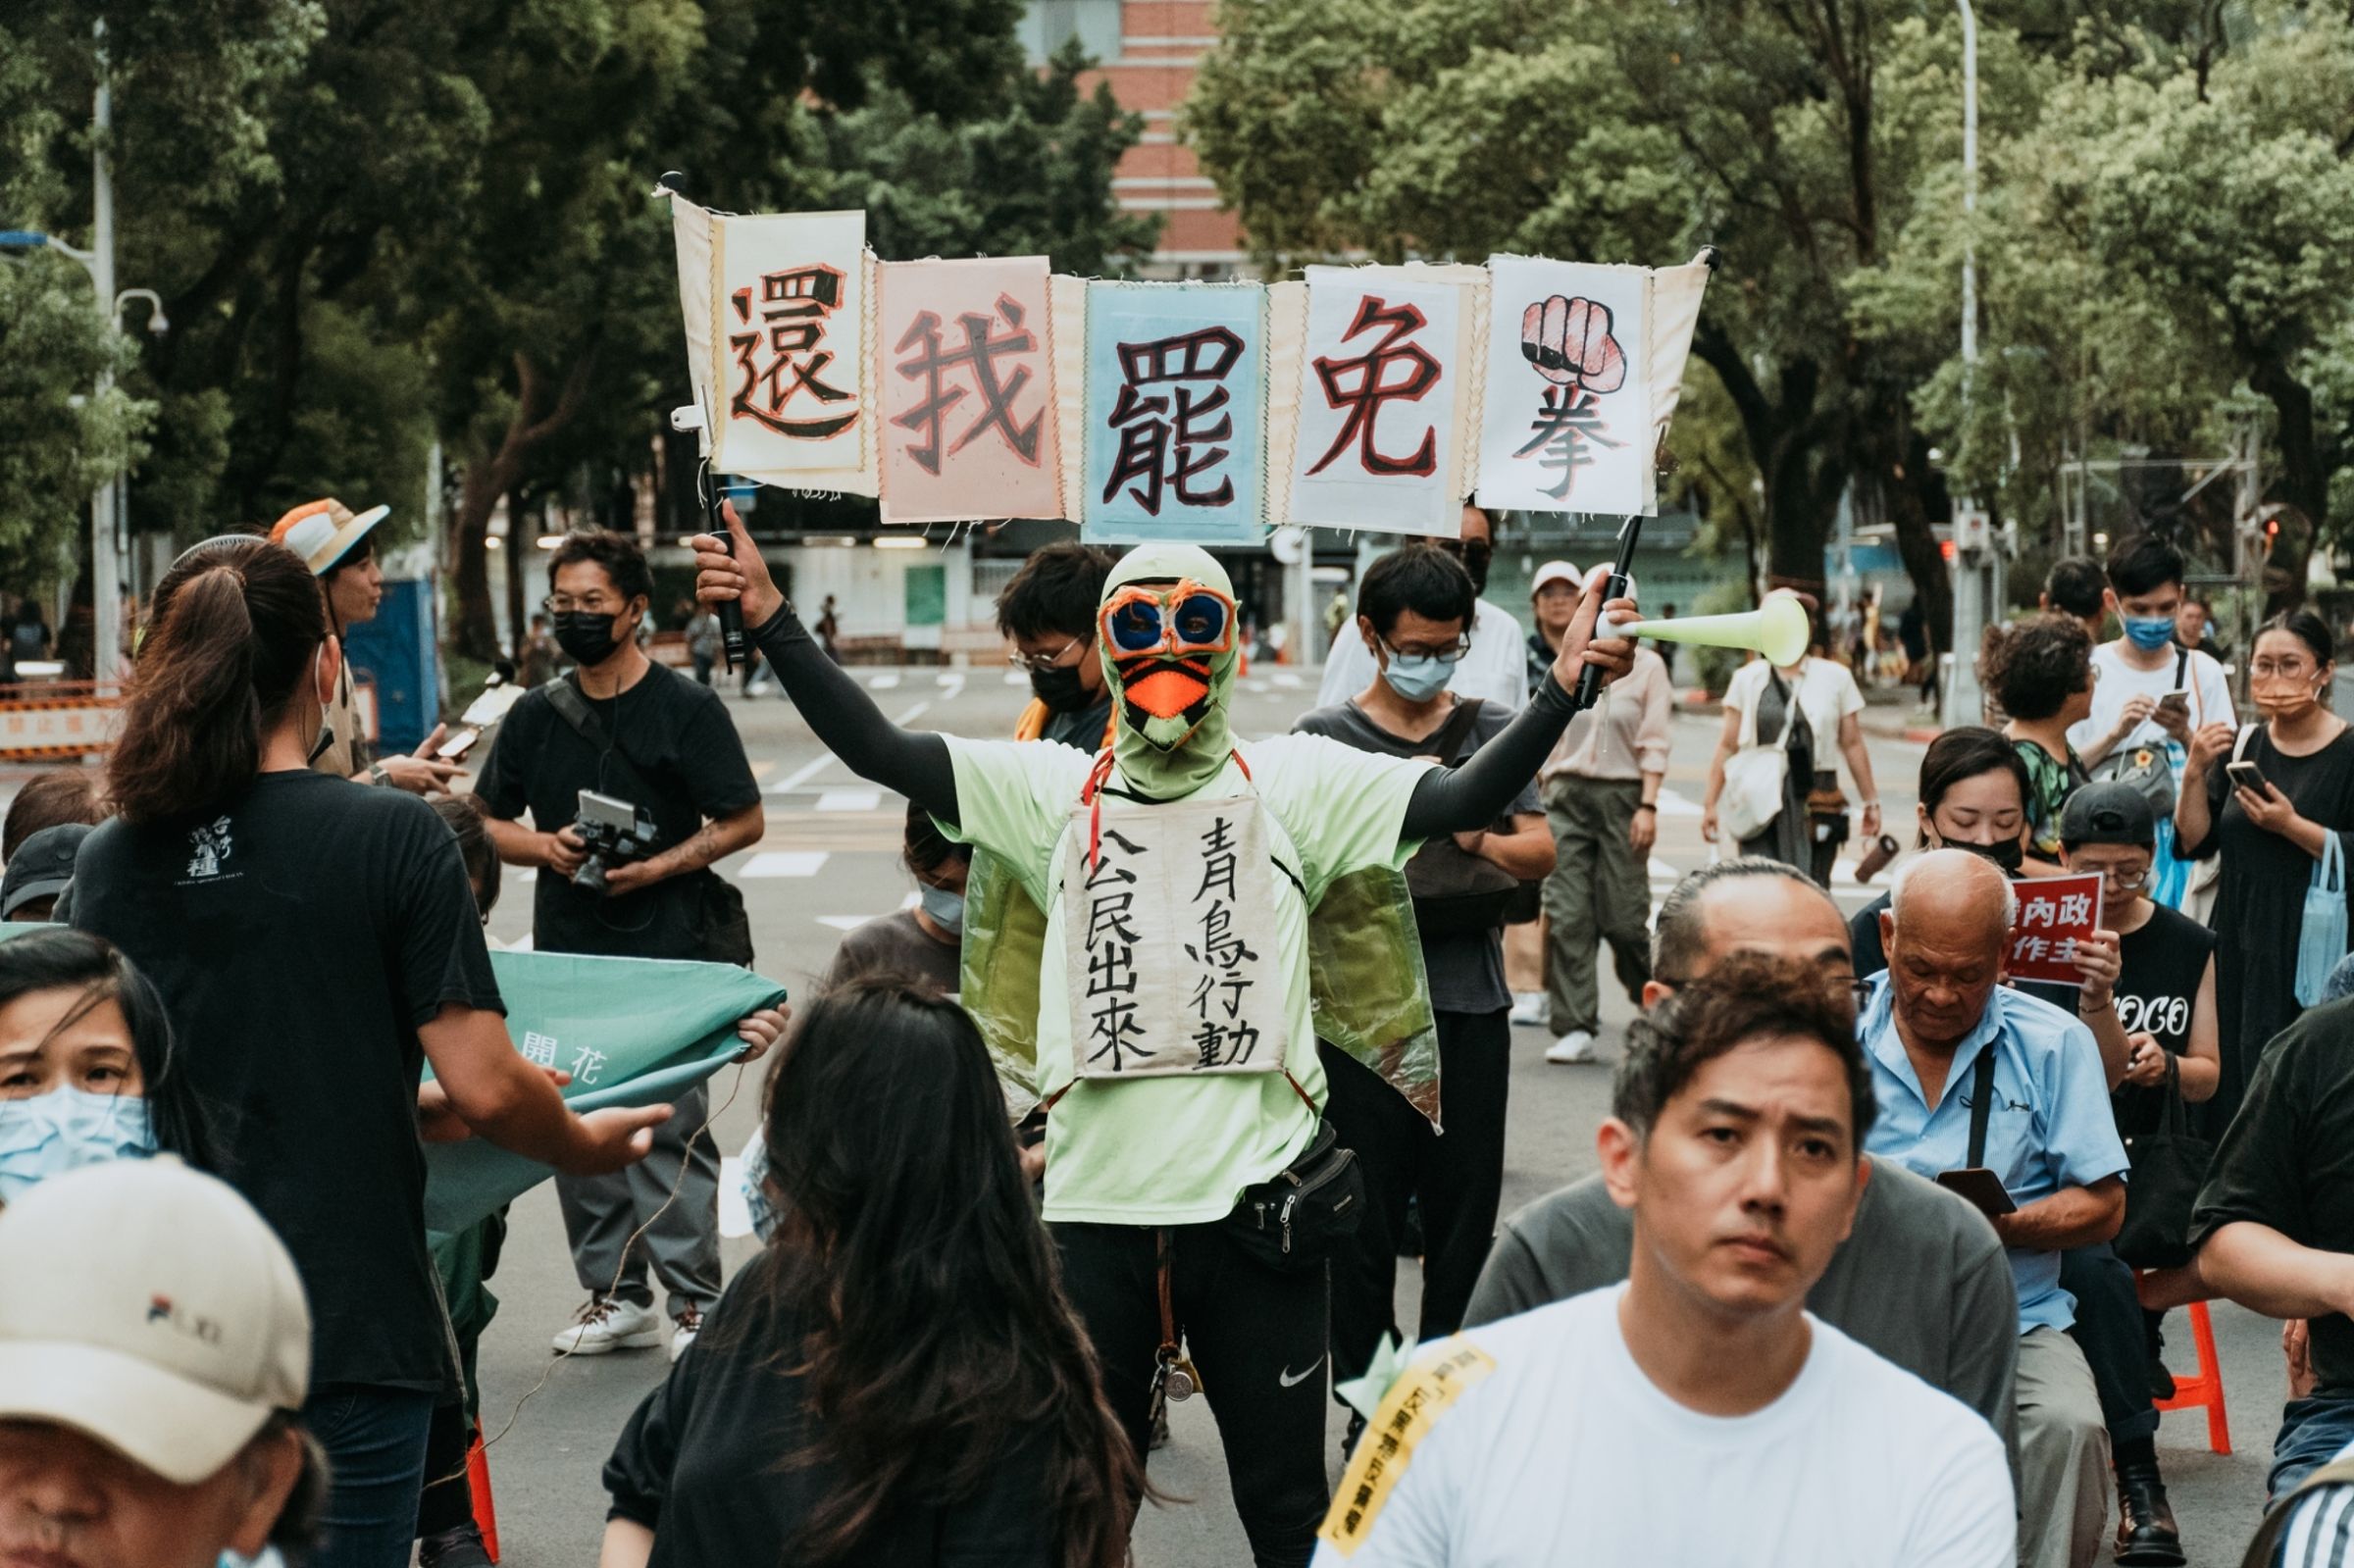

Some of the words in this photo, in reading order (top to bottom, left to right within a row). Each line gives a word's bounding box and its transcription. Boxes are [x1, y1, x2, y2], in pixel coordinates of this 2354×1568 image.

[2011, 892, 2092, 928] 內政
[1080, 830, 1157, 1072] 公民出來
[1185, 817, 1259, 1071] 青鳥行動
[2113, 994, 2189, 1036] OCO
[522, 1031, 608, 1086] 開花
